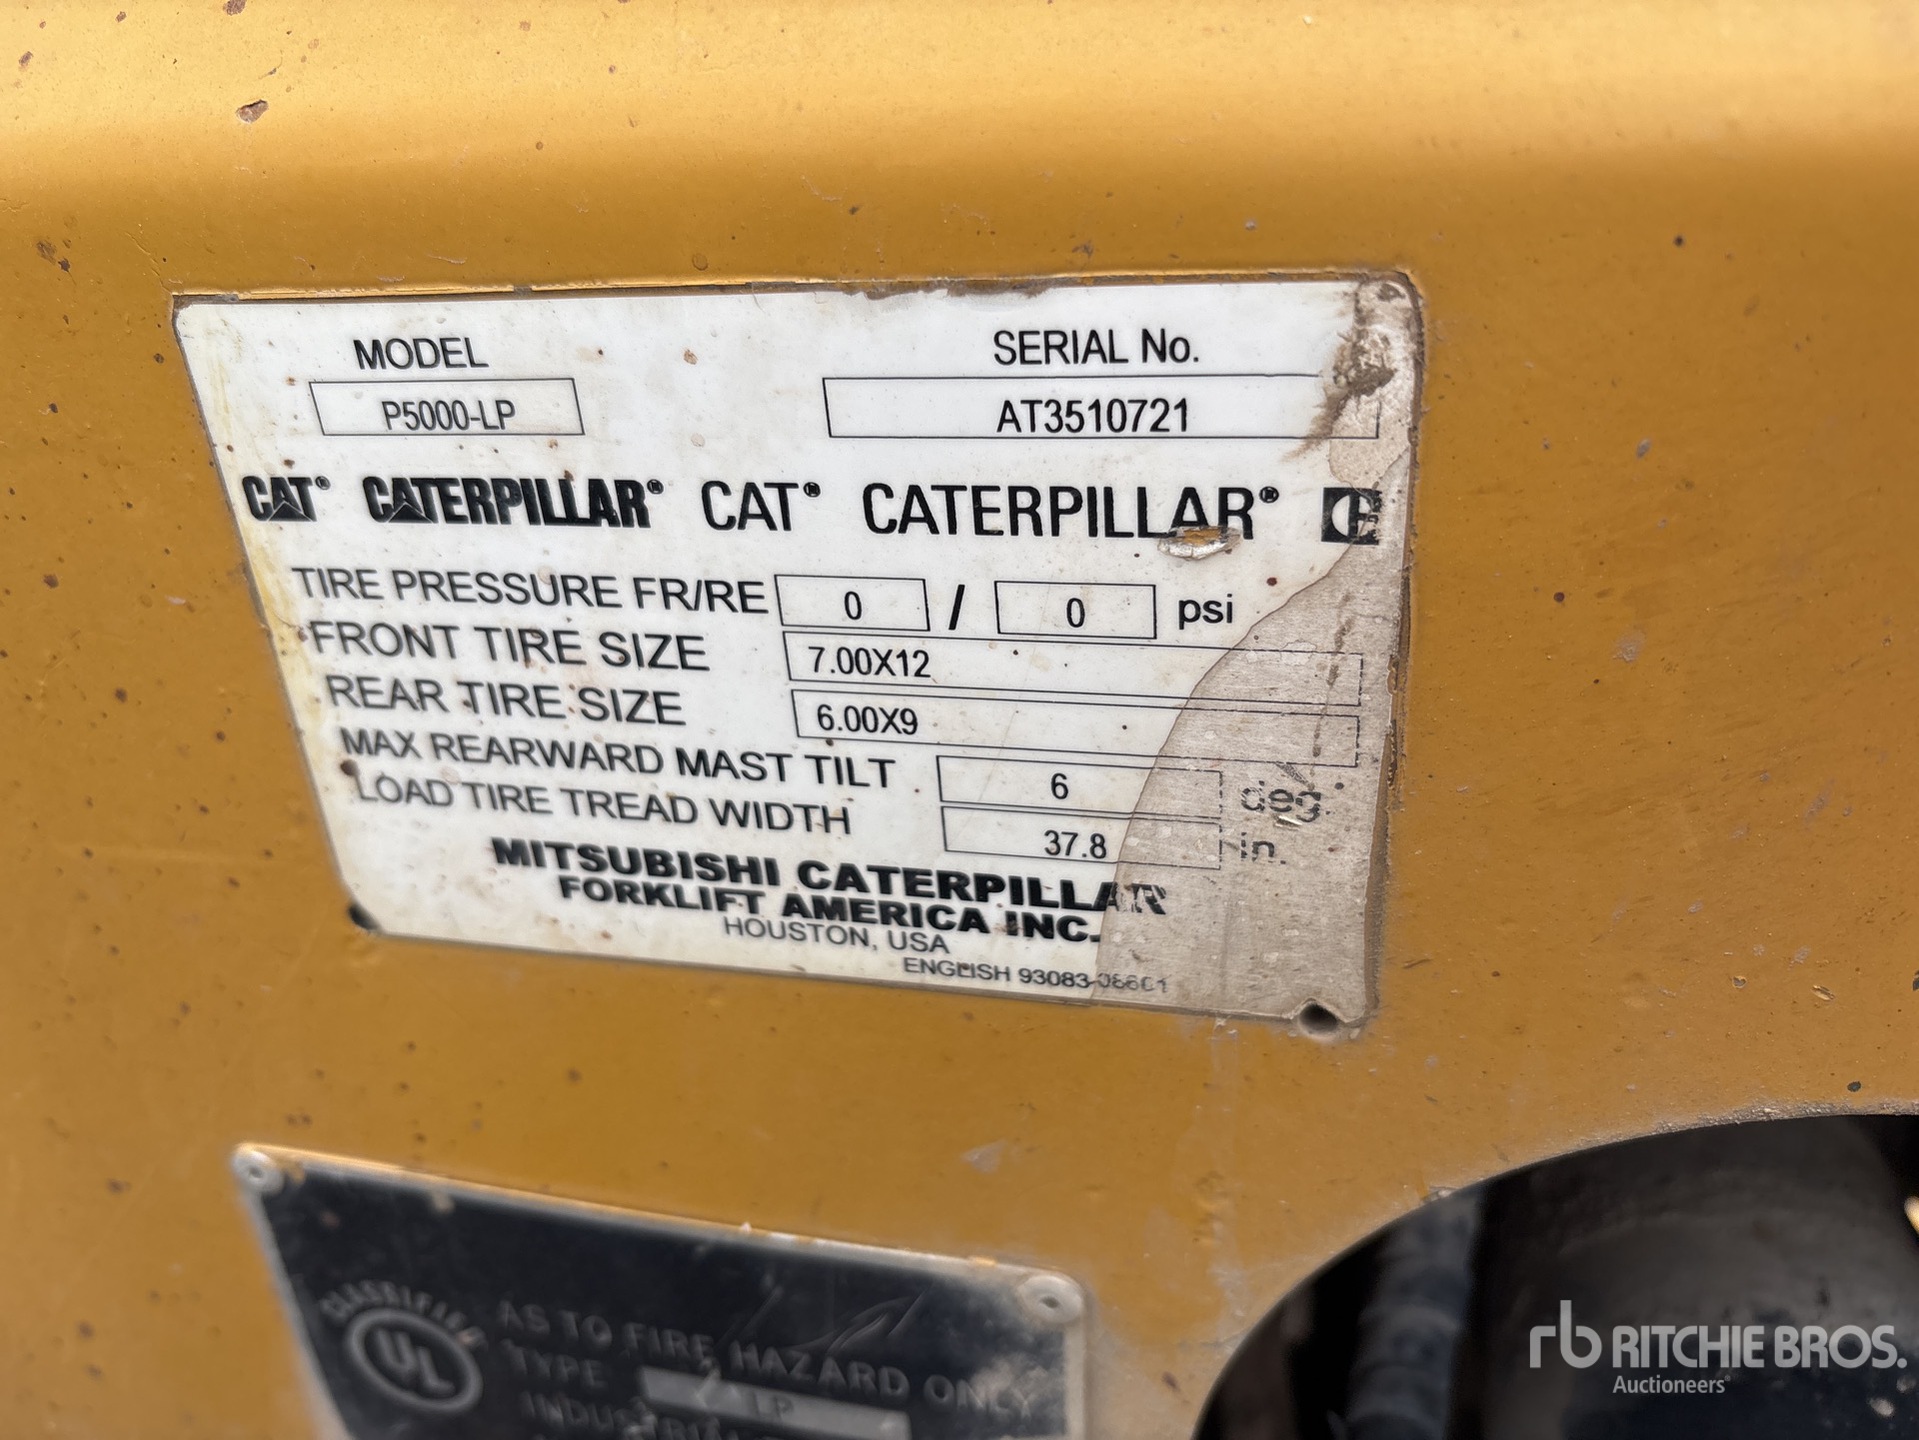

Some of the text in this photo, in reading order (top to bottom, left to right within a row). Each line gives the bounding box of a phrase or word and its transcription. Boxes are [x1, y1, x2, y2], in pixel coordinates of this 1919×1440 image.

[353, 337, 489, 369] MODEL
[994, 329, 1200, 365] SERIAL No.
[381, 400, 516, 431] P5000-LP
[997, 398, 1189, 433] AT3510721
[292, 567, 769, 614] TIRE PRESSURE FR/RE
[844, 591, 862, 620] 0
[1066, 597, 1085, 628] 0
[1178, 593, 1233, 630] psi
[310, 620, 710, 671] FRONT TIRE SIZE
[808, 646, 931, 678] 7.00X12
[326, 674, 687, 726] REAR TIRE SIZE
[817, 704, 918, 735] 6.00X9
[340, 727, 896, 788] MAX REARWARD MAST TILT
[356, 773, 851, 835] LOAD TIRE TREAD WIDTH
[1051, 773, 1069, 800] 6
[1044, 830, 1107, 860] 37.8
[491, 837, 1168, 915] MITSUBISHI CATERPILLAR
[560, 876, 1100, 943] FORKLIFT AMERICA INC.
[724, 915, 951, 955] HOUSTON, USA
[903, 956, 1011, 983] ENGLISH
[373, 1327, 456, 1395] UL
[497, 1299, 550, 1336] AS
[557, 1308, 613, 1348] TO
[620, 1321, 714, 1363] FIRE
[729, 1339, 911, 1400] HAZARD
[499, 1338, 608, 1392] TYPE
